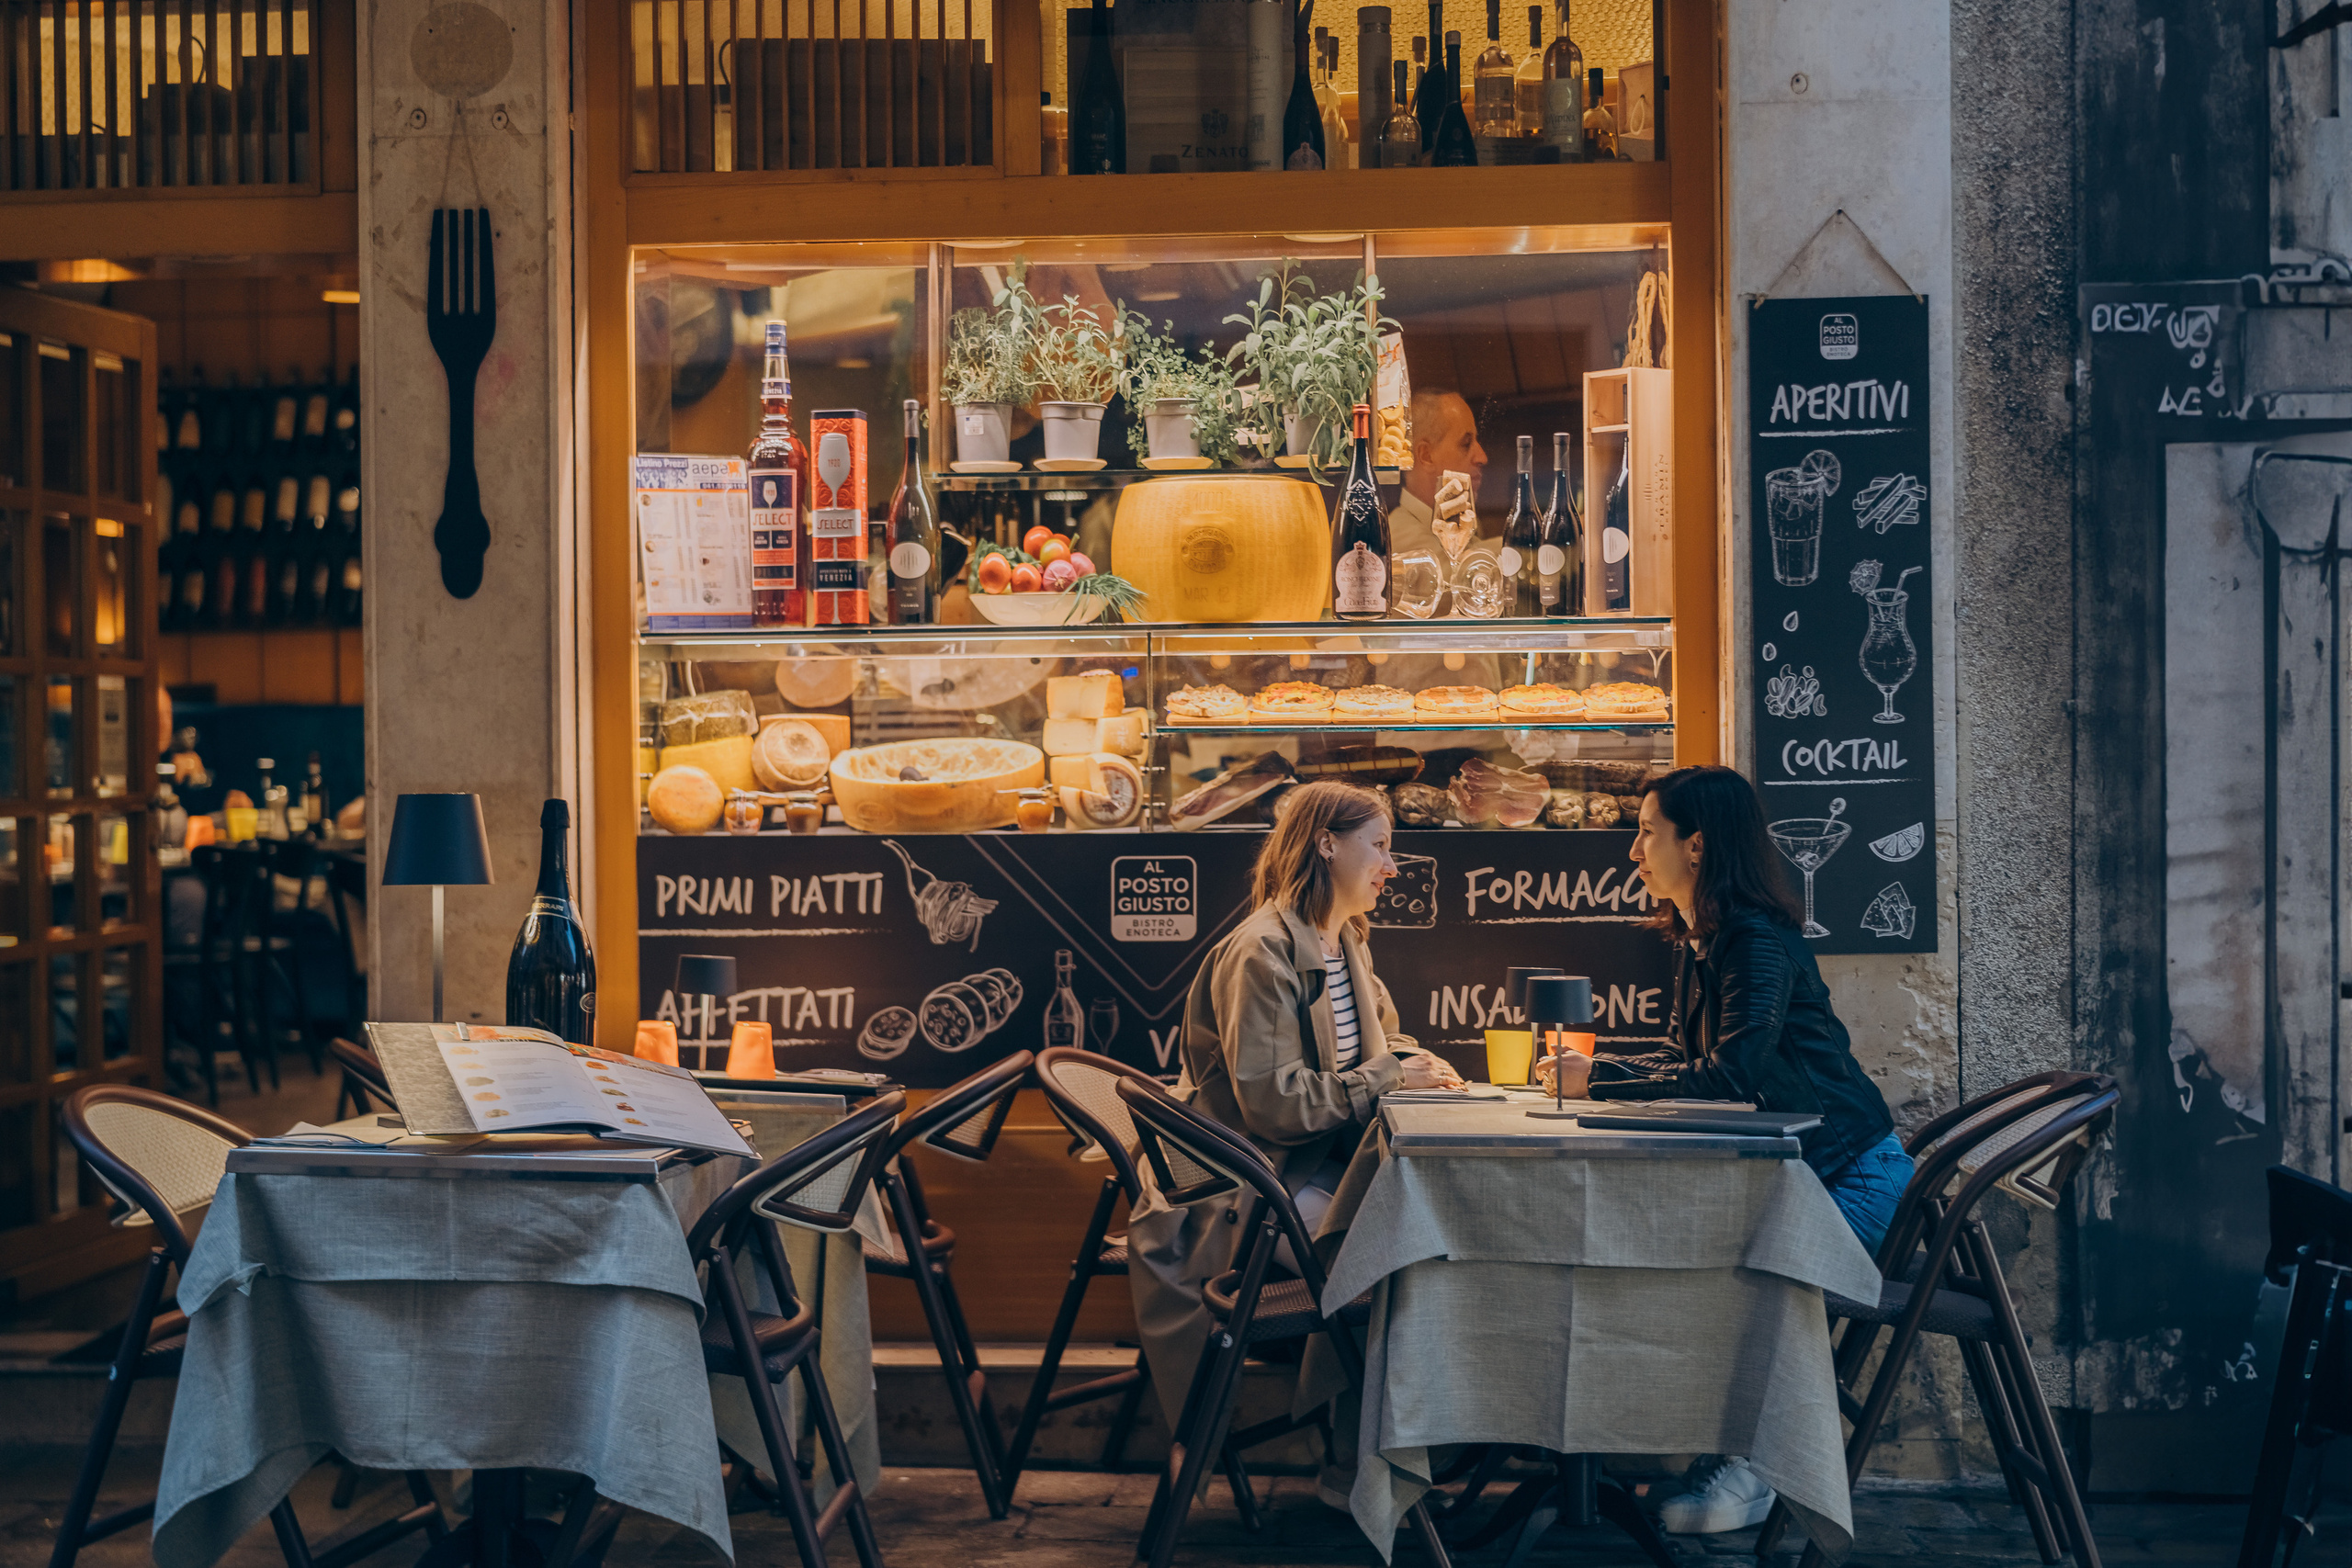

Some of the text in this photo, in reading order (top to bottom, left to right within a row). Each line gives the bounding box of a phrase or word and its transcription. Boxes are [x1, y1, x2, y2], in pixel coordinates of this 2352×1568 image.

[1182, 144, 1249, 159] ZENATO
[1823, 325, 1854, 334] POSTO
[1823, 335, 1854, 344] GIUSTO
[1770, 379, 1908, 423] APERITIVI
[752, 513, 793, 525] SELECT
[817, 518, 854, 530] SELECT
[1781, 738, 1907, 776] COCKTAIL
[1143, 861, 1165, 874] AL
[1119, 877, 1190, 894] POSTO
[655, 872, 884, 918] PRIMI PIATTI
[1117, 897, 1190, 912] GIUSTO
[1132, 918, 1174, 928] BISTRÒ
[1125, 929, 1181, 937] ENOTECA
